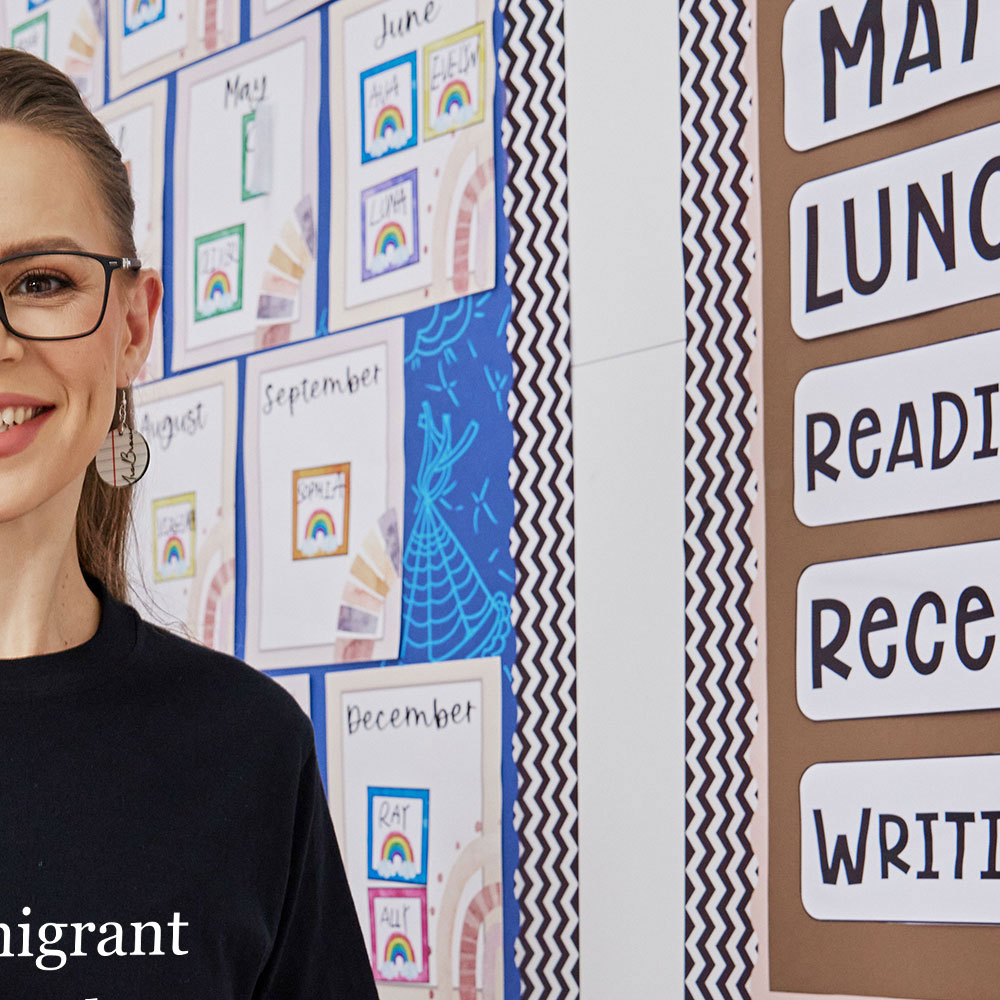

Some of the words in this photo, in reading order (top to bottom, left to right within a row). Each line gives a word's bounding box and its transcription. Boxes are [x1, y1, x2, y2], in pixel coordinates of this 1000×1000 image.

[374, 1, 442, 50] June
[224, 75, 267, 110] May
[263, 364, 384, 416] September
[141, 401, 206, 450] August
[346, 698, 477, 735] December
[379, 801, 410, 830] RAY
[813, 808, 1000, 886] WRITI
